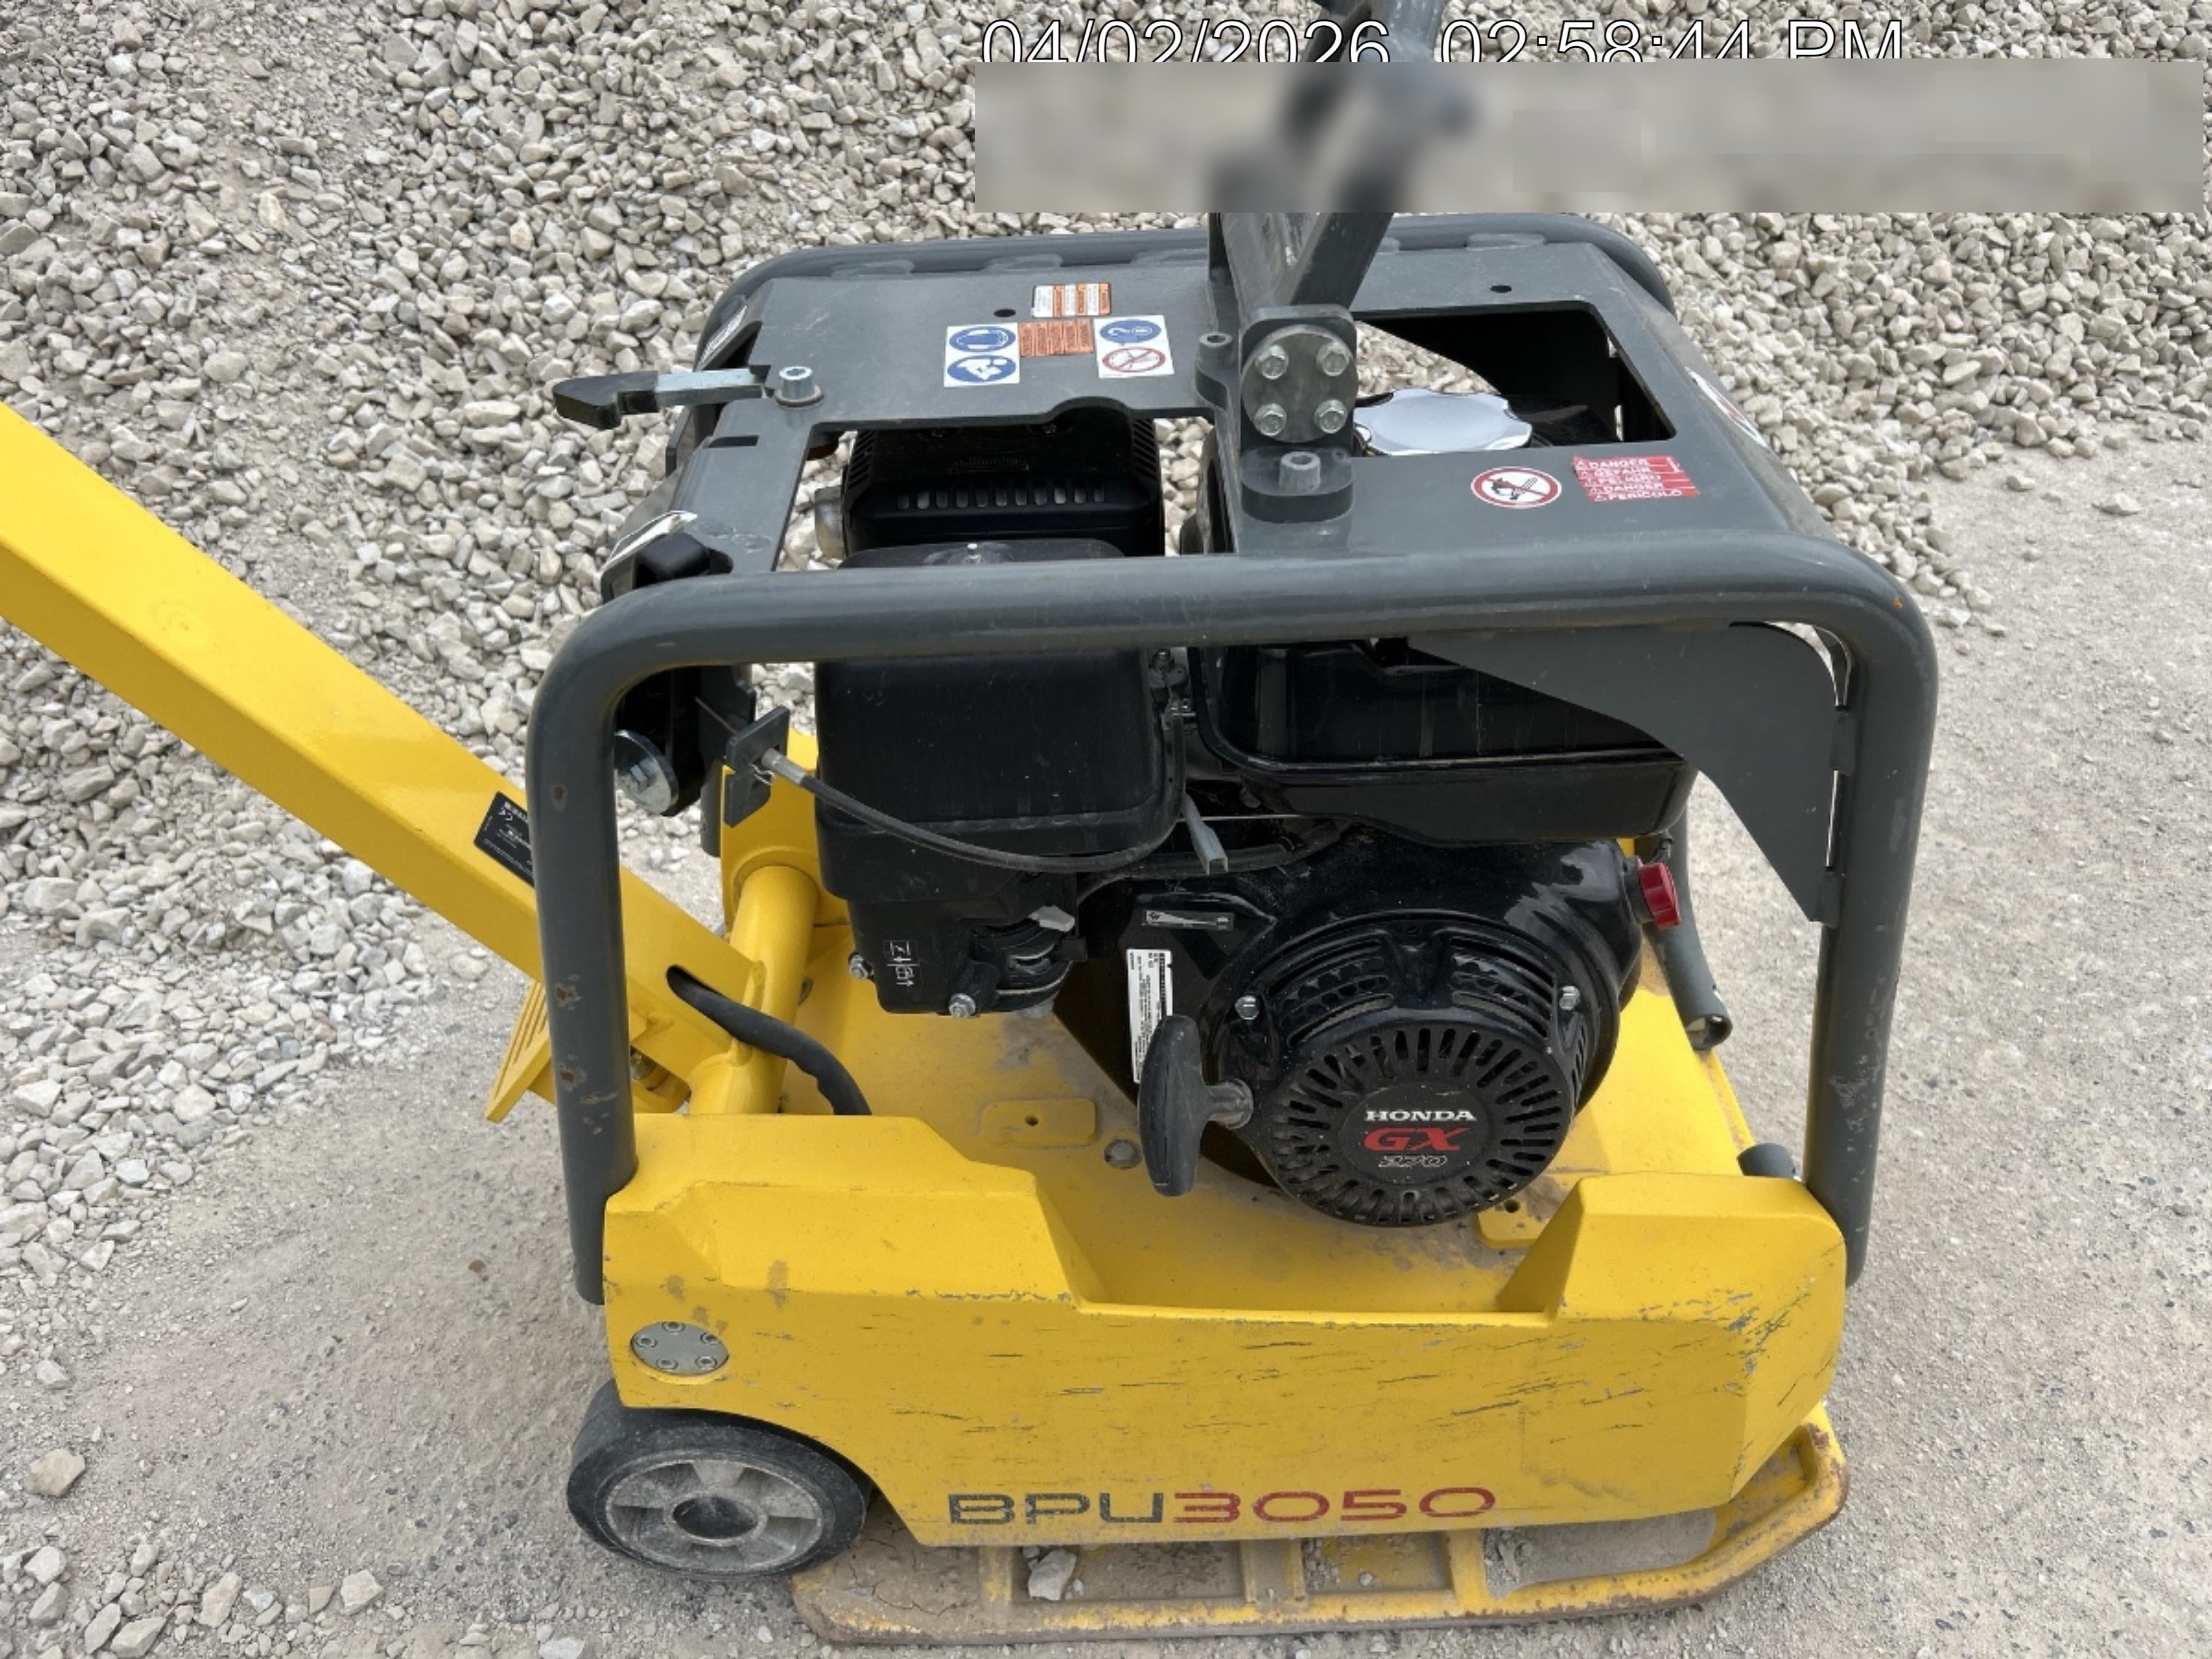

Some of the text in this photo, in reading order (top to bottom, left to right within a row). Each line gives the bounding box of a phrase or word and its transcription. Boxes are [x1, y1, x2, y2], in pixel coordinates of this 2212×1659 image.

[1589, 458, 1649, 468] DANGER
[1364, 1109, 1477, 1122] HONDA
[1363, 1126, 1472, 1151] GX
[1378, 1155, 1448, 1168] 270
[948, 1486, 1496, 1524] BPU3050
